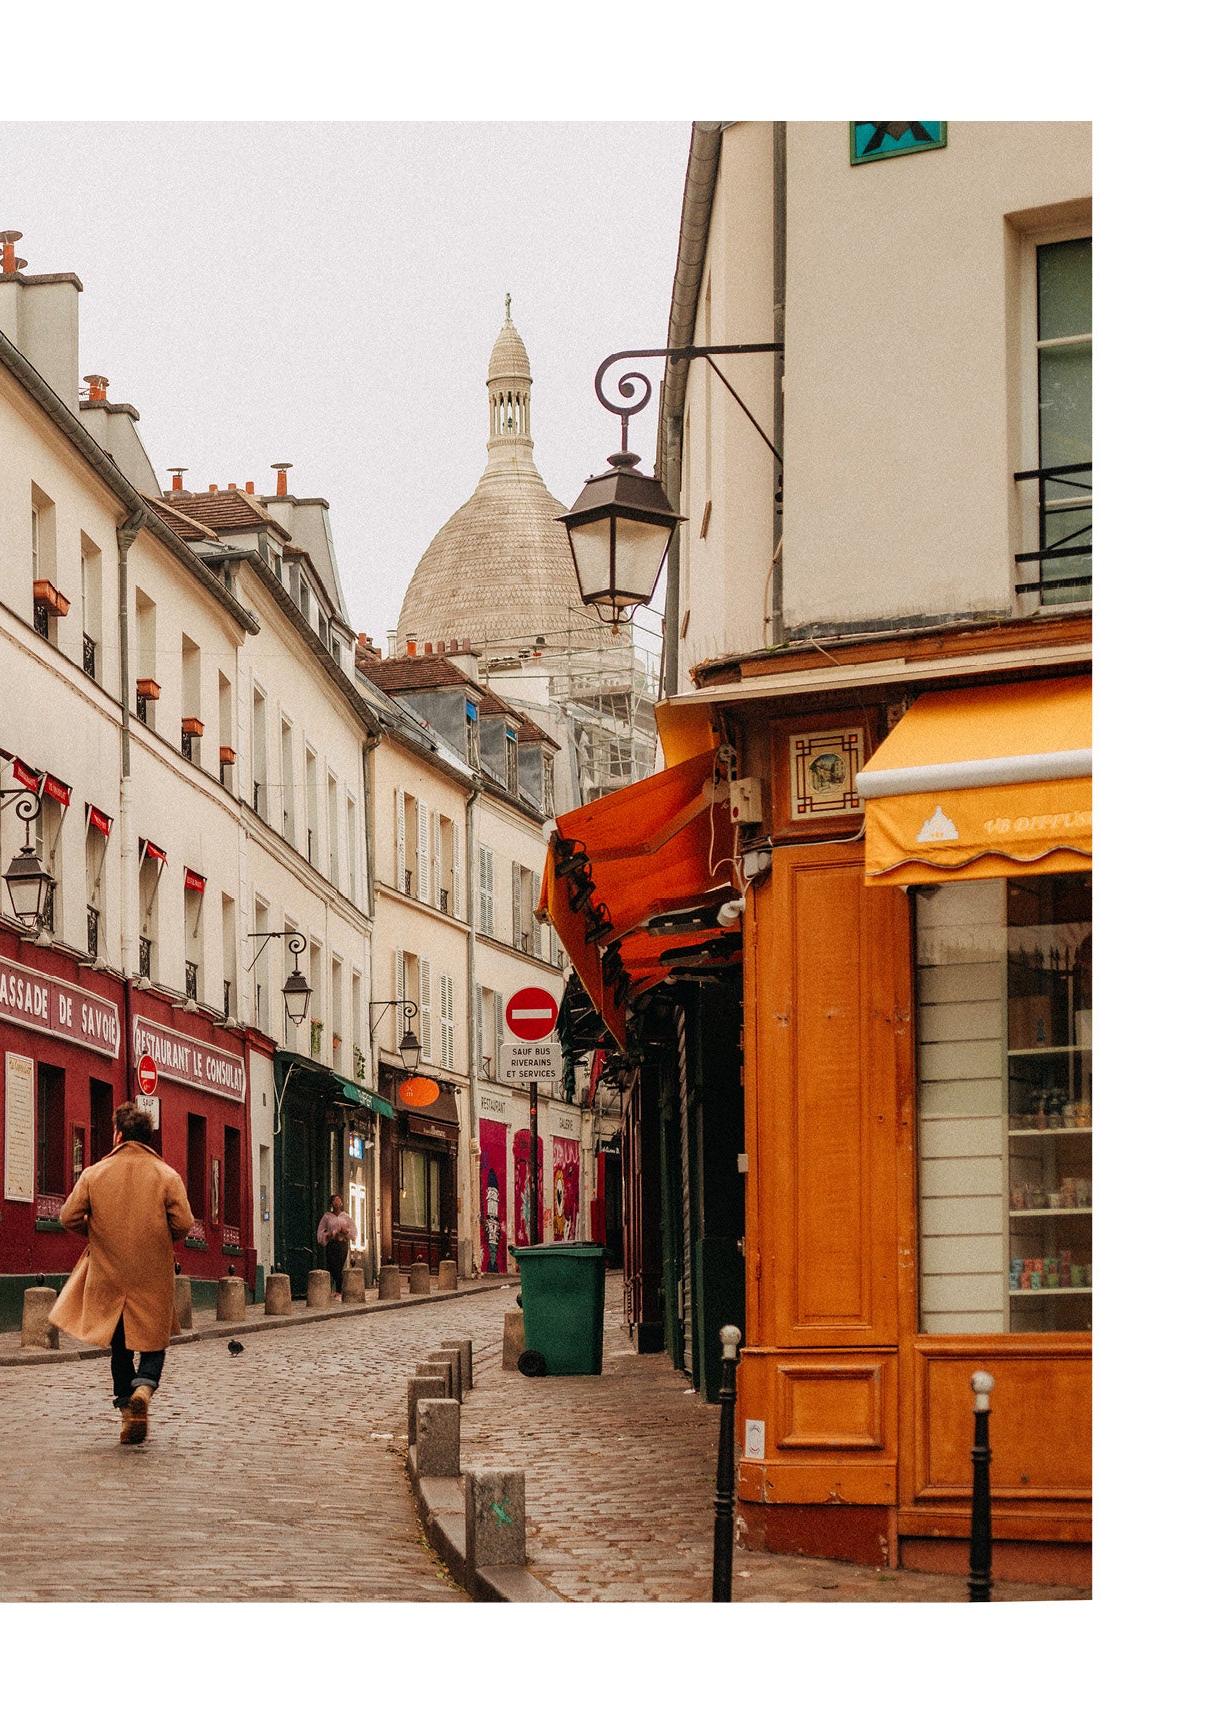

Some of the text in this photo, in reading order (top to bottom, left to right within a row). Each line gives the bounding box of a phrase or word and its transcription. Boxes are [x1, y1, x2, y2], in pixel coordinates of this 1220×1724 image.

[59, 994, 73, 1028] DE
[81, 1003, 116, 1046] SAVOIE
[135, 1028, 243, 1092] RESTAURANT LE CONSULAT
[511, 1059, 551, 1067] RIVERAINS
[506, 1070, 556, 1078] ET SERVICES
[480, 1096, 506, 1114] RESTAURANT
